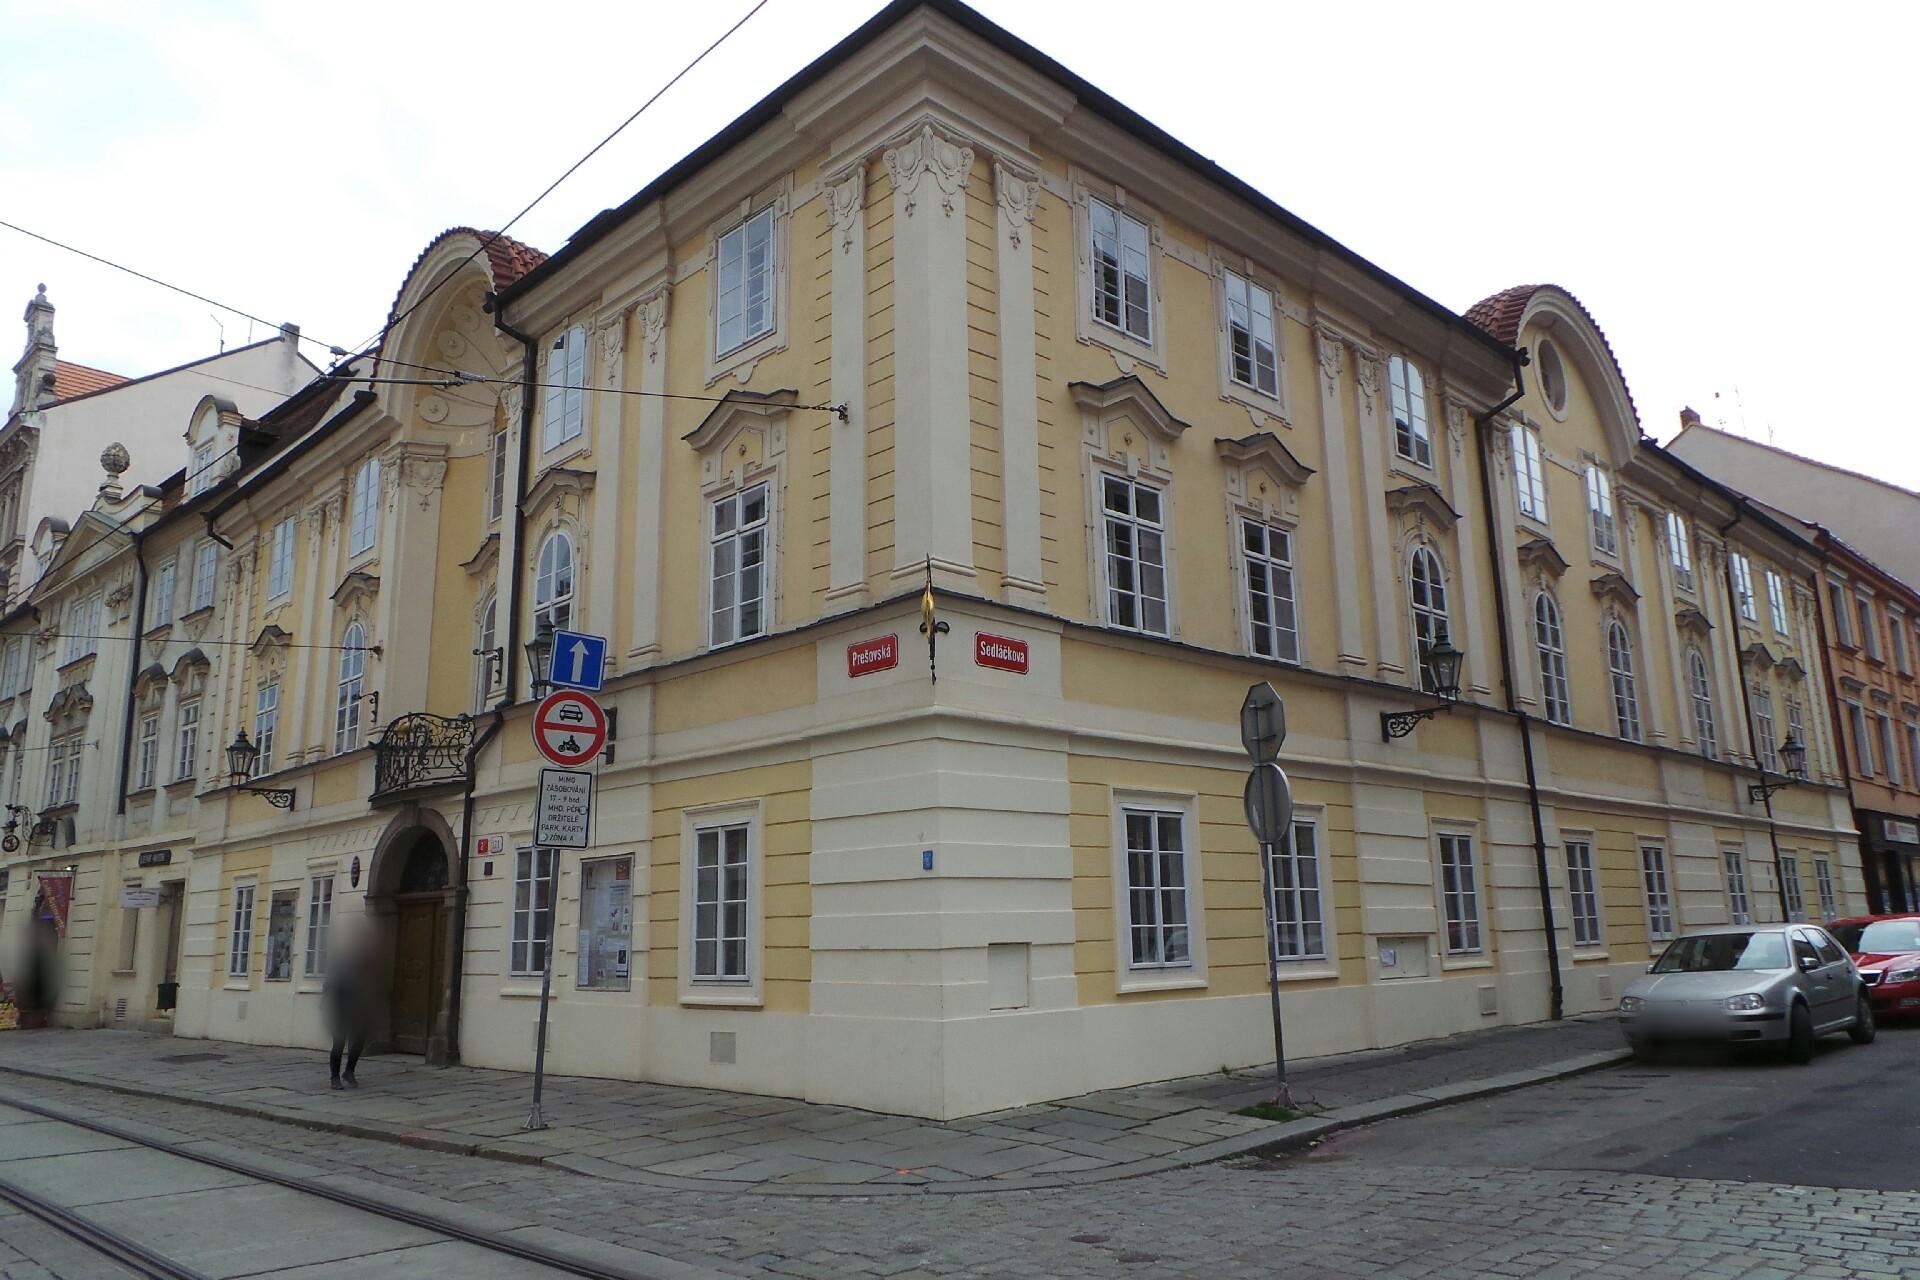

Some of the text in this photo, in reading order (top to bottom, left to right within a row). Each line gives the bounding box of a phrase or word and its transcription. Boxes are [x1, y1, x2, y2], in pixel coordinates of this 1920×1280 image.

[852, 644, 891, 667] Prešovská
[980, 640, 1025, 663] Sedláčkova
[558, 775, 576, 784] MIMO
[562, 825, 584, 833] KARTY
